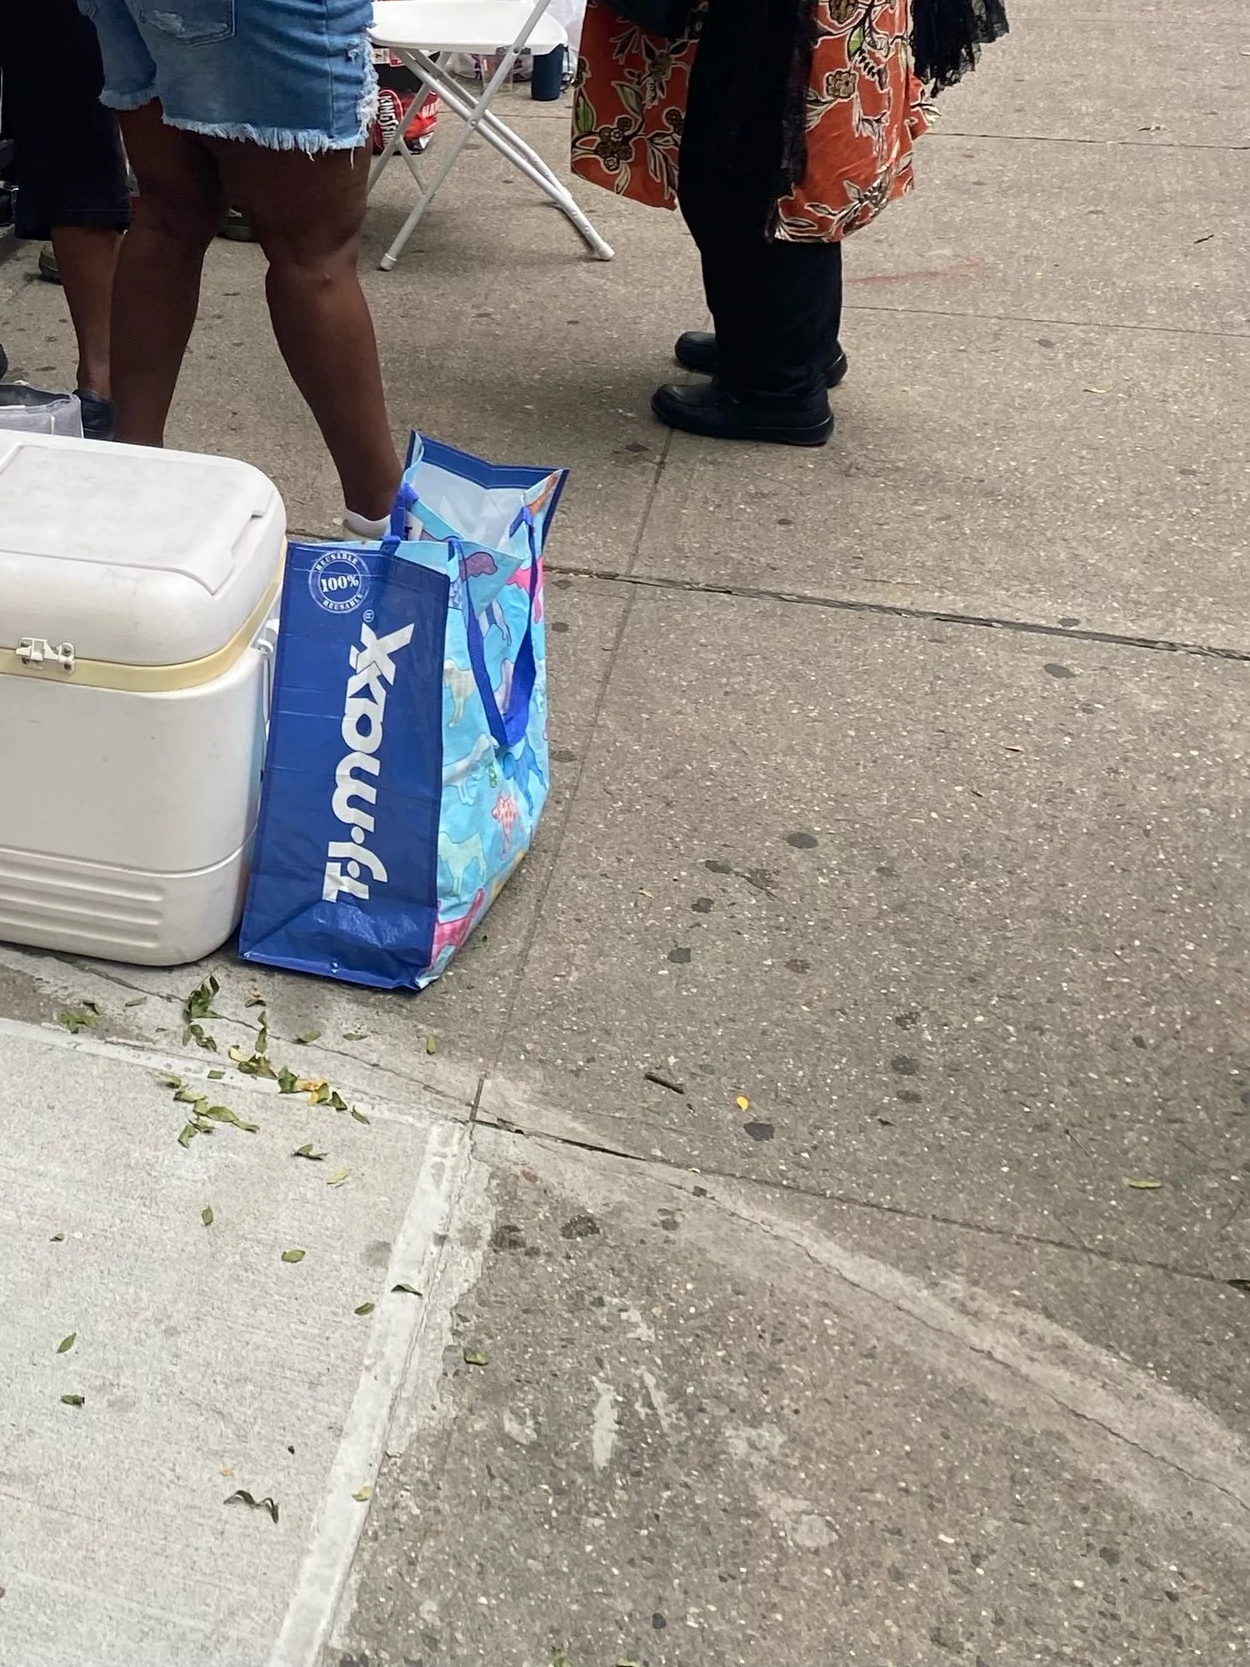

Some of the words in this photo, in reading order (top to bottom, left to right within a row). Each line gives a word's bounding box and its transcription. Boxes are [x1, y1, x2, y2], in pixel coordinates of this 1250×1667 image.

[315, 553, 359, 572] REUSABLE
[321, 574, 359, 593] 100%
[322, 592, 364, 611] REUSABLE
